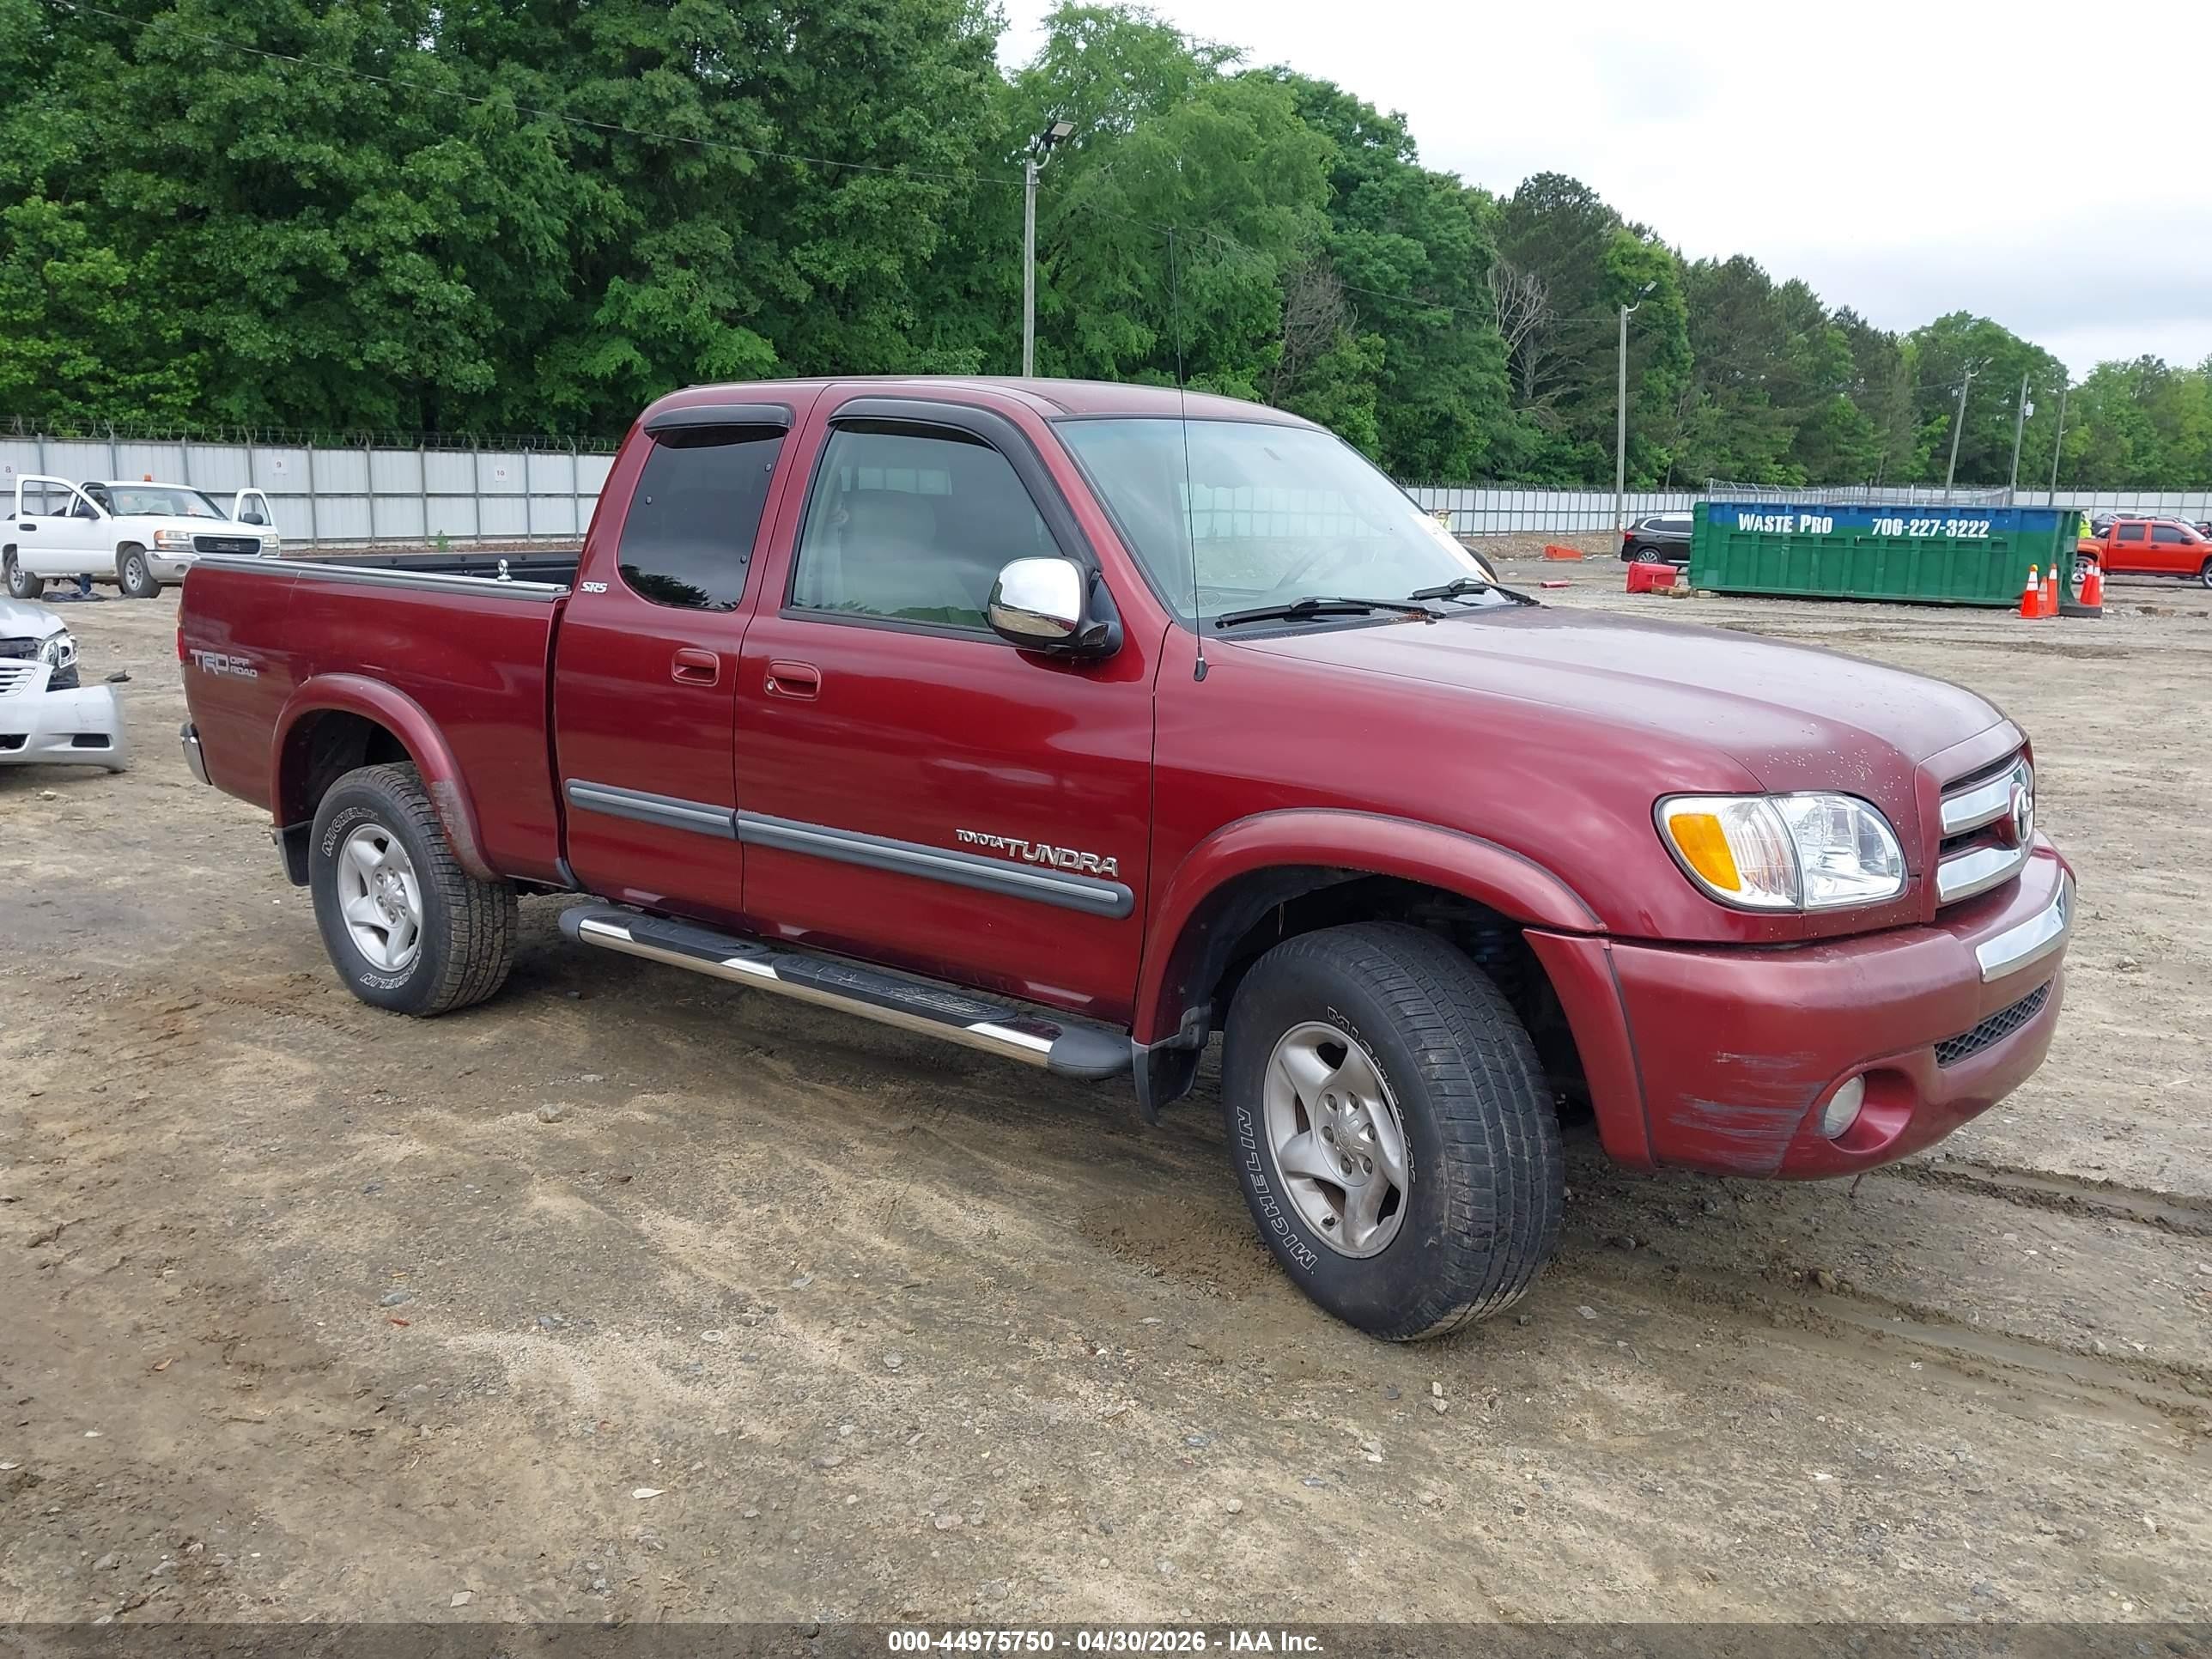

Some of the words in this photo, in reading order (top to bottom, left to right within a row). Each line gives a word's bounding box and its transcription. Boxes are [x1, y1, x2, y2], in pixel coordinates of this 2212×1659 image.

[1871, 518, 1990, 538] 706-227-3222
[580, 581, 608, 593] SR5
[190, 648, 229, 675] TRD
[229, 655, 249, 665] OFF
[230, 665, 258, 678] ROAD
[321, 807, 379, 857] MICHELIN
[956, 829, 1005, 849] TOYOTA
[1002, 837, 1119, 878] TUNDRA
[1237, 1106, 1318, 1271] MICHELIN
